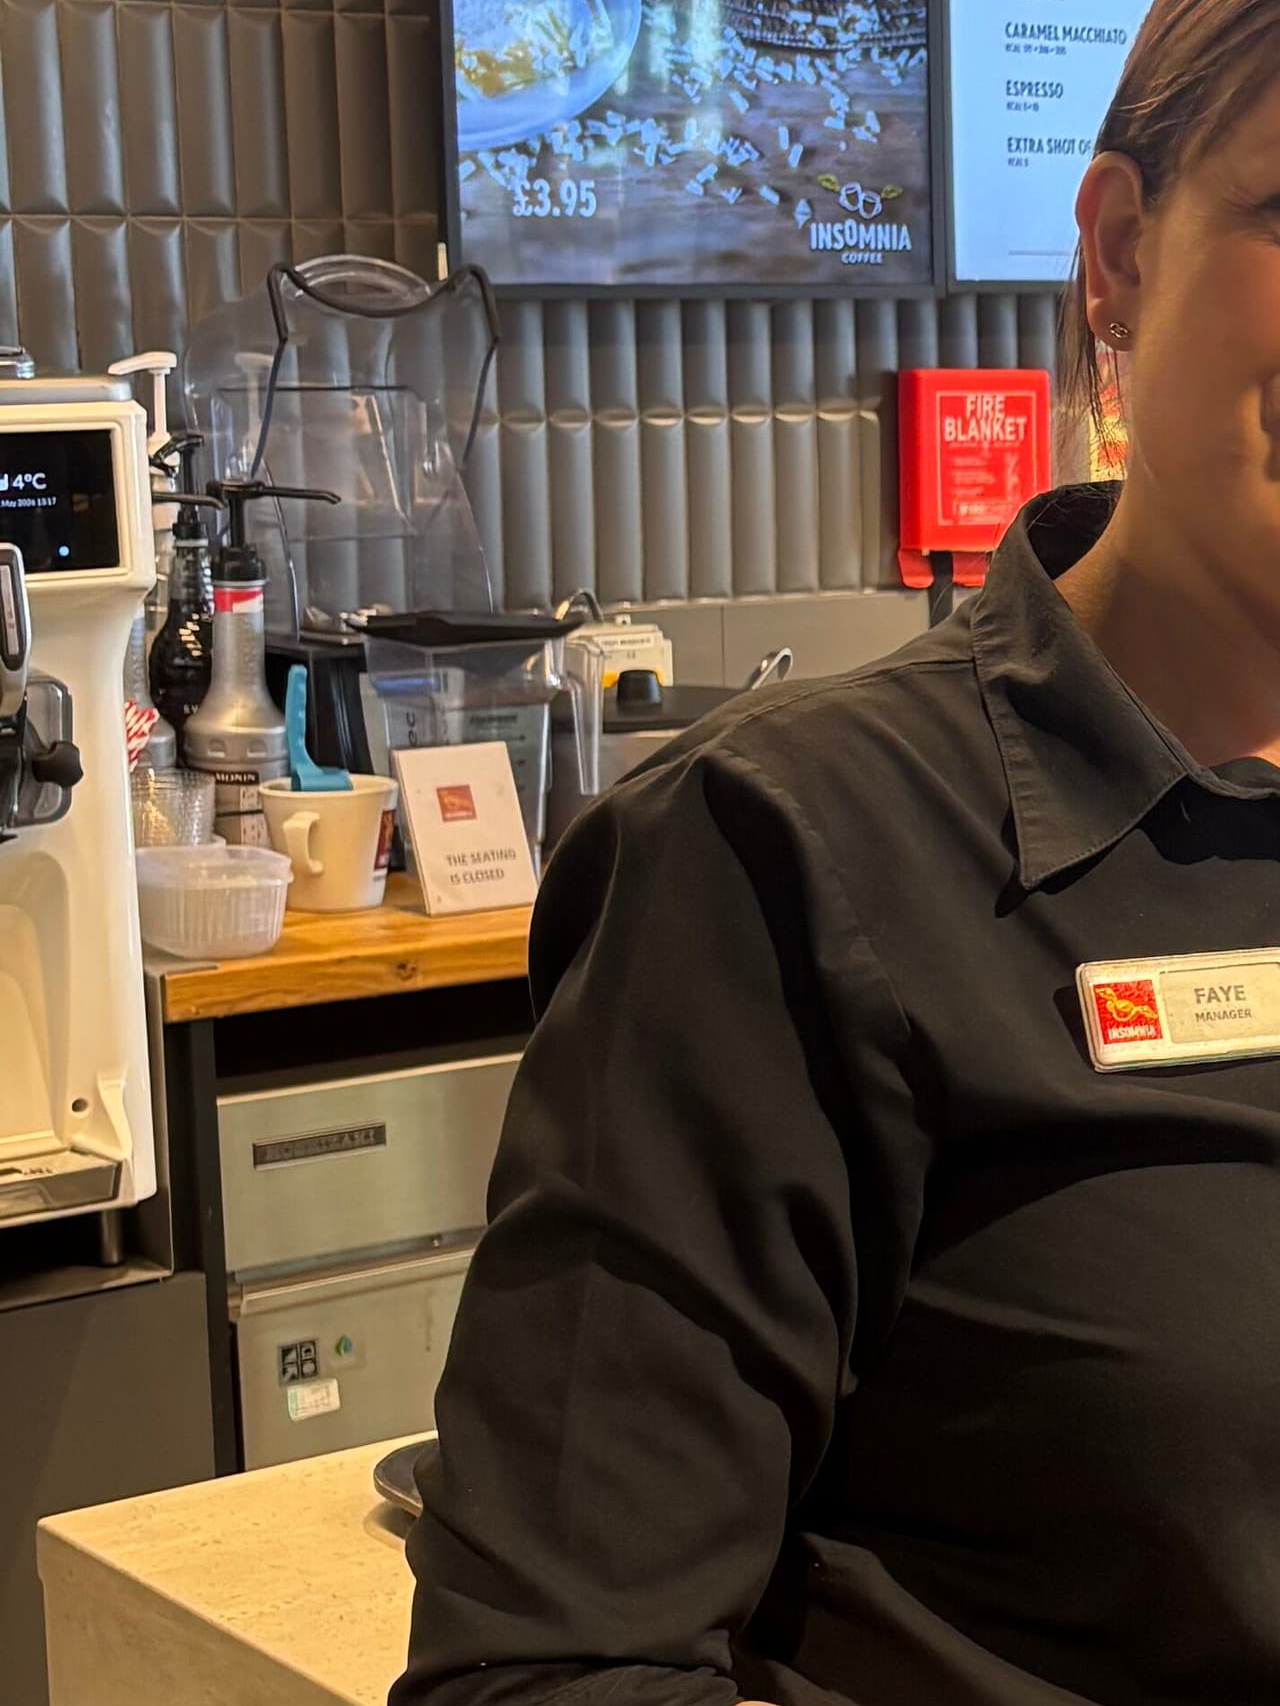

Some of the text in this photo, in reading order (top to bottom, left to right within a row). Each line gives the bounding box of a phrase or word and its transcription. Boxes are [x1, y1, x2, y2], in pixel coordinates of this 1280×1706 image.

[1005, 22, 1127, 45] CARAMEL MACCHIATO
[1006, 80, 1063, 99] ESPRESSO
[1007, 137, 1044, 154] EXTRA
[1047, 138, 1075, 155] SHOT
[512, 178, 598, 220] £3.95
[810, 218, 912, 251] INSOMNIA
[841, 252, 882, 265] COFFEE
[966, 395, 1006, 419] FIRE
[944, 416, 1028, 442] BLANKET
[446, 849, 517, 867] THE SEATING
[450, 868, 506, 886] IS CLOSED
[1194, 984, 1247, 1004] FAYE
[1194, 1007, 1253, 1023] MANAGER
[1107, 1024, 1156, 1040] INSOMNIA
